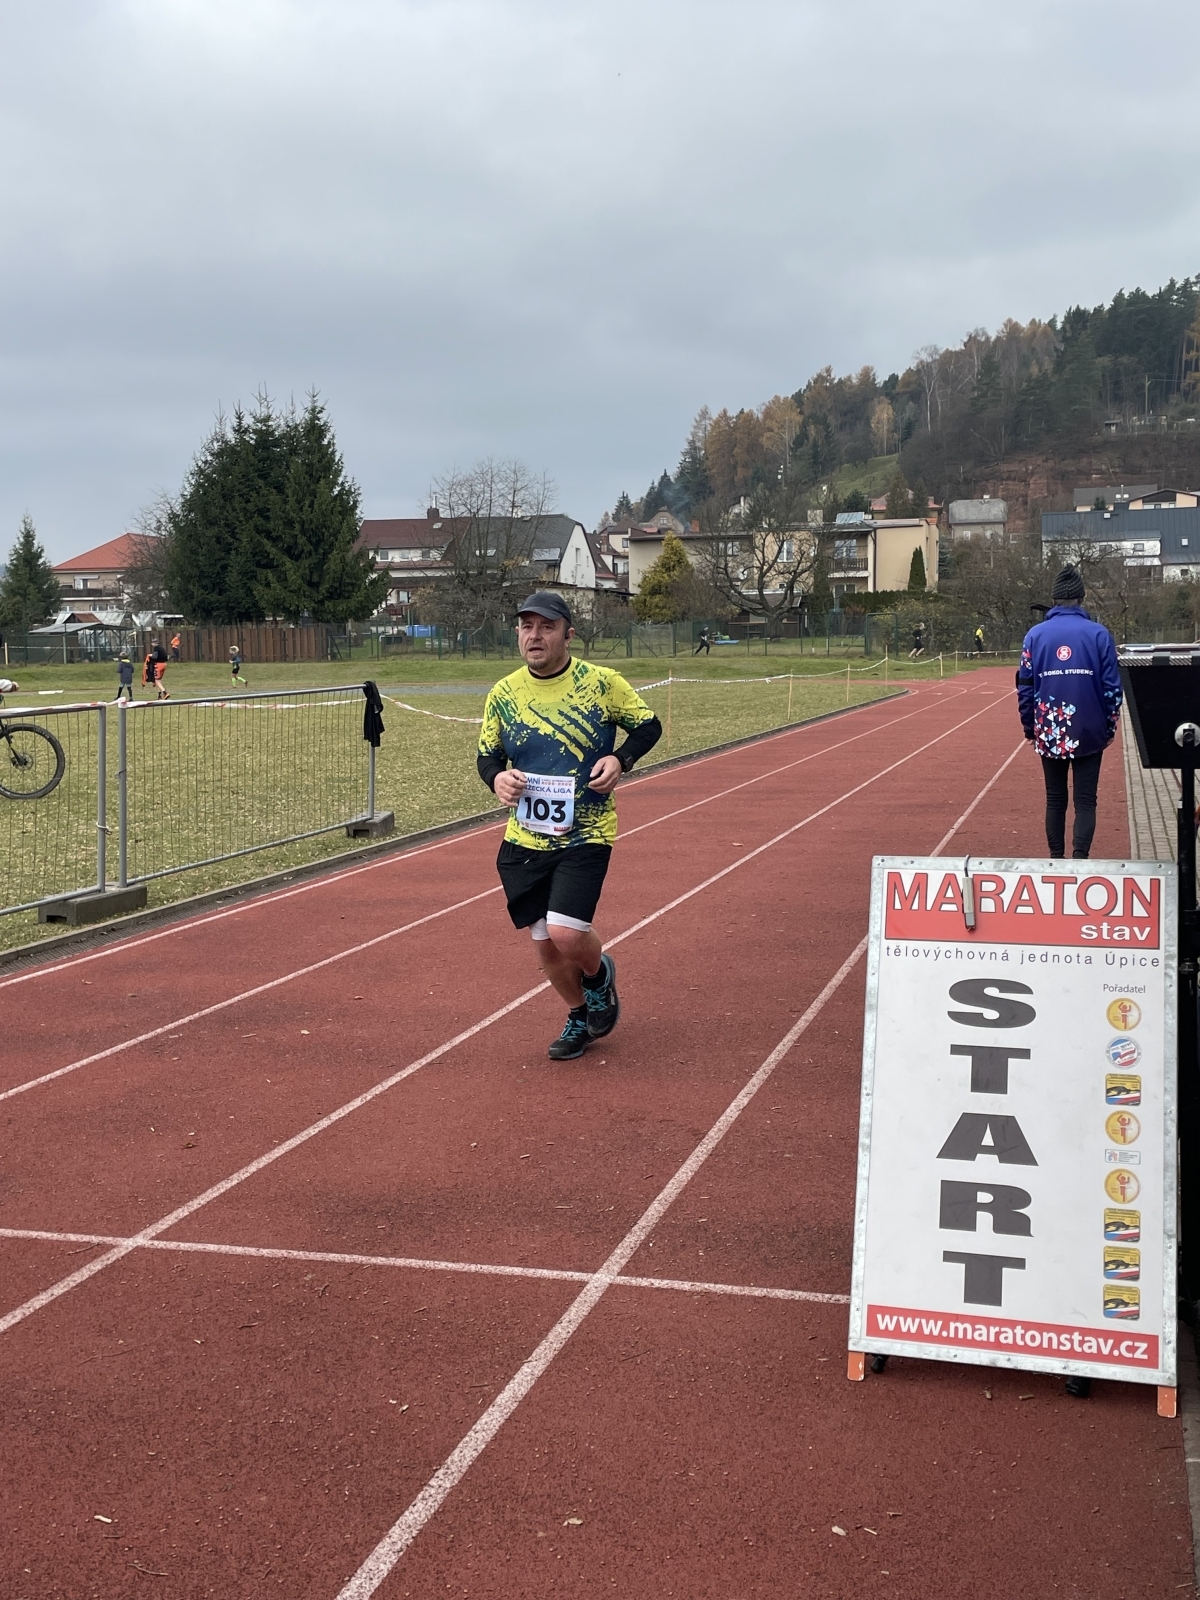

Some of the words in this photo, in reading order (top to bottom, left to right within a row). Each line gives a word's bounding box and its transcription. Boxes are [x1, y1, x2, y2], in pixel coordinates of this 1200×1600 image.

[525, 797, 566, 823] 103
[886, 871, 1161, 917] MARATON
[1080, 921, 1152, 941] stav
[885, 945, 1010, 962] tělovýchovná
[1020, 949, 1093, 965] jednota
[1105, 950, 1160, 968] Úpice
[1103, 983, 1146, 994] Pořadatel
[936, 978, 1039, 1307] START
[876, 1313, 1149, 1360] www.maratonstav.cz
